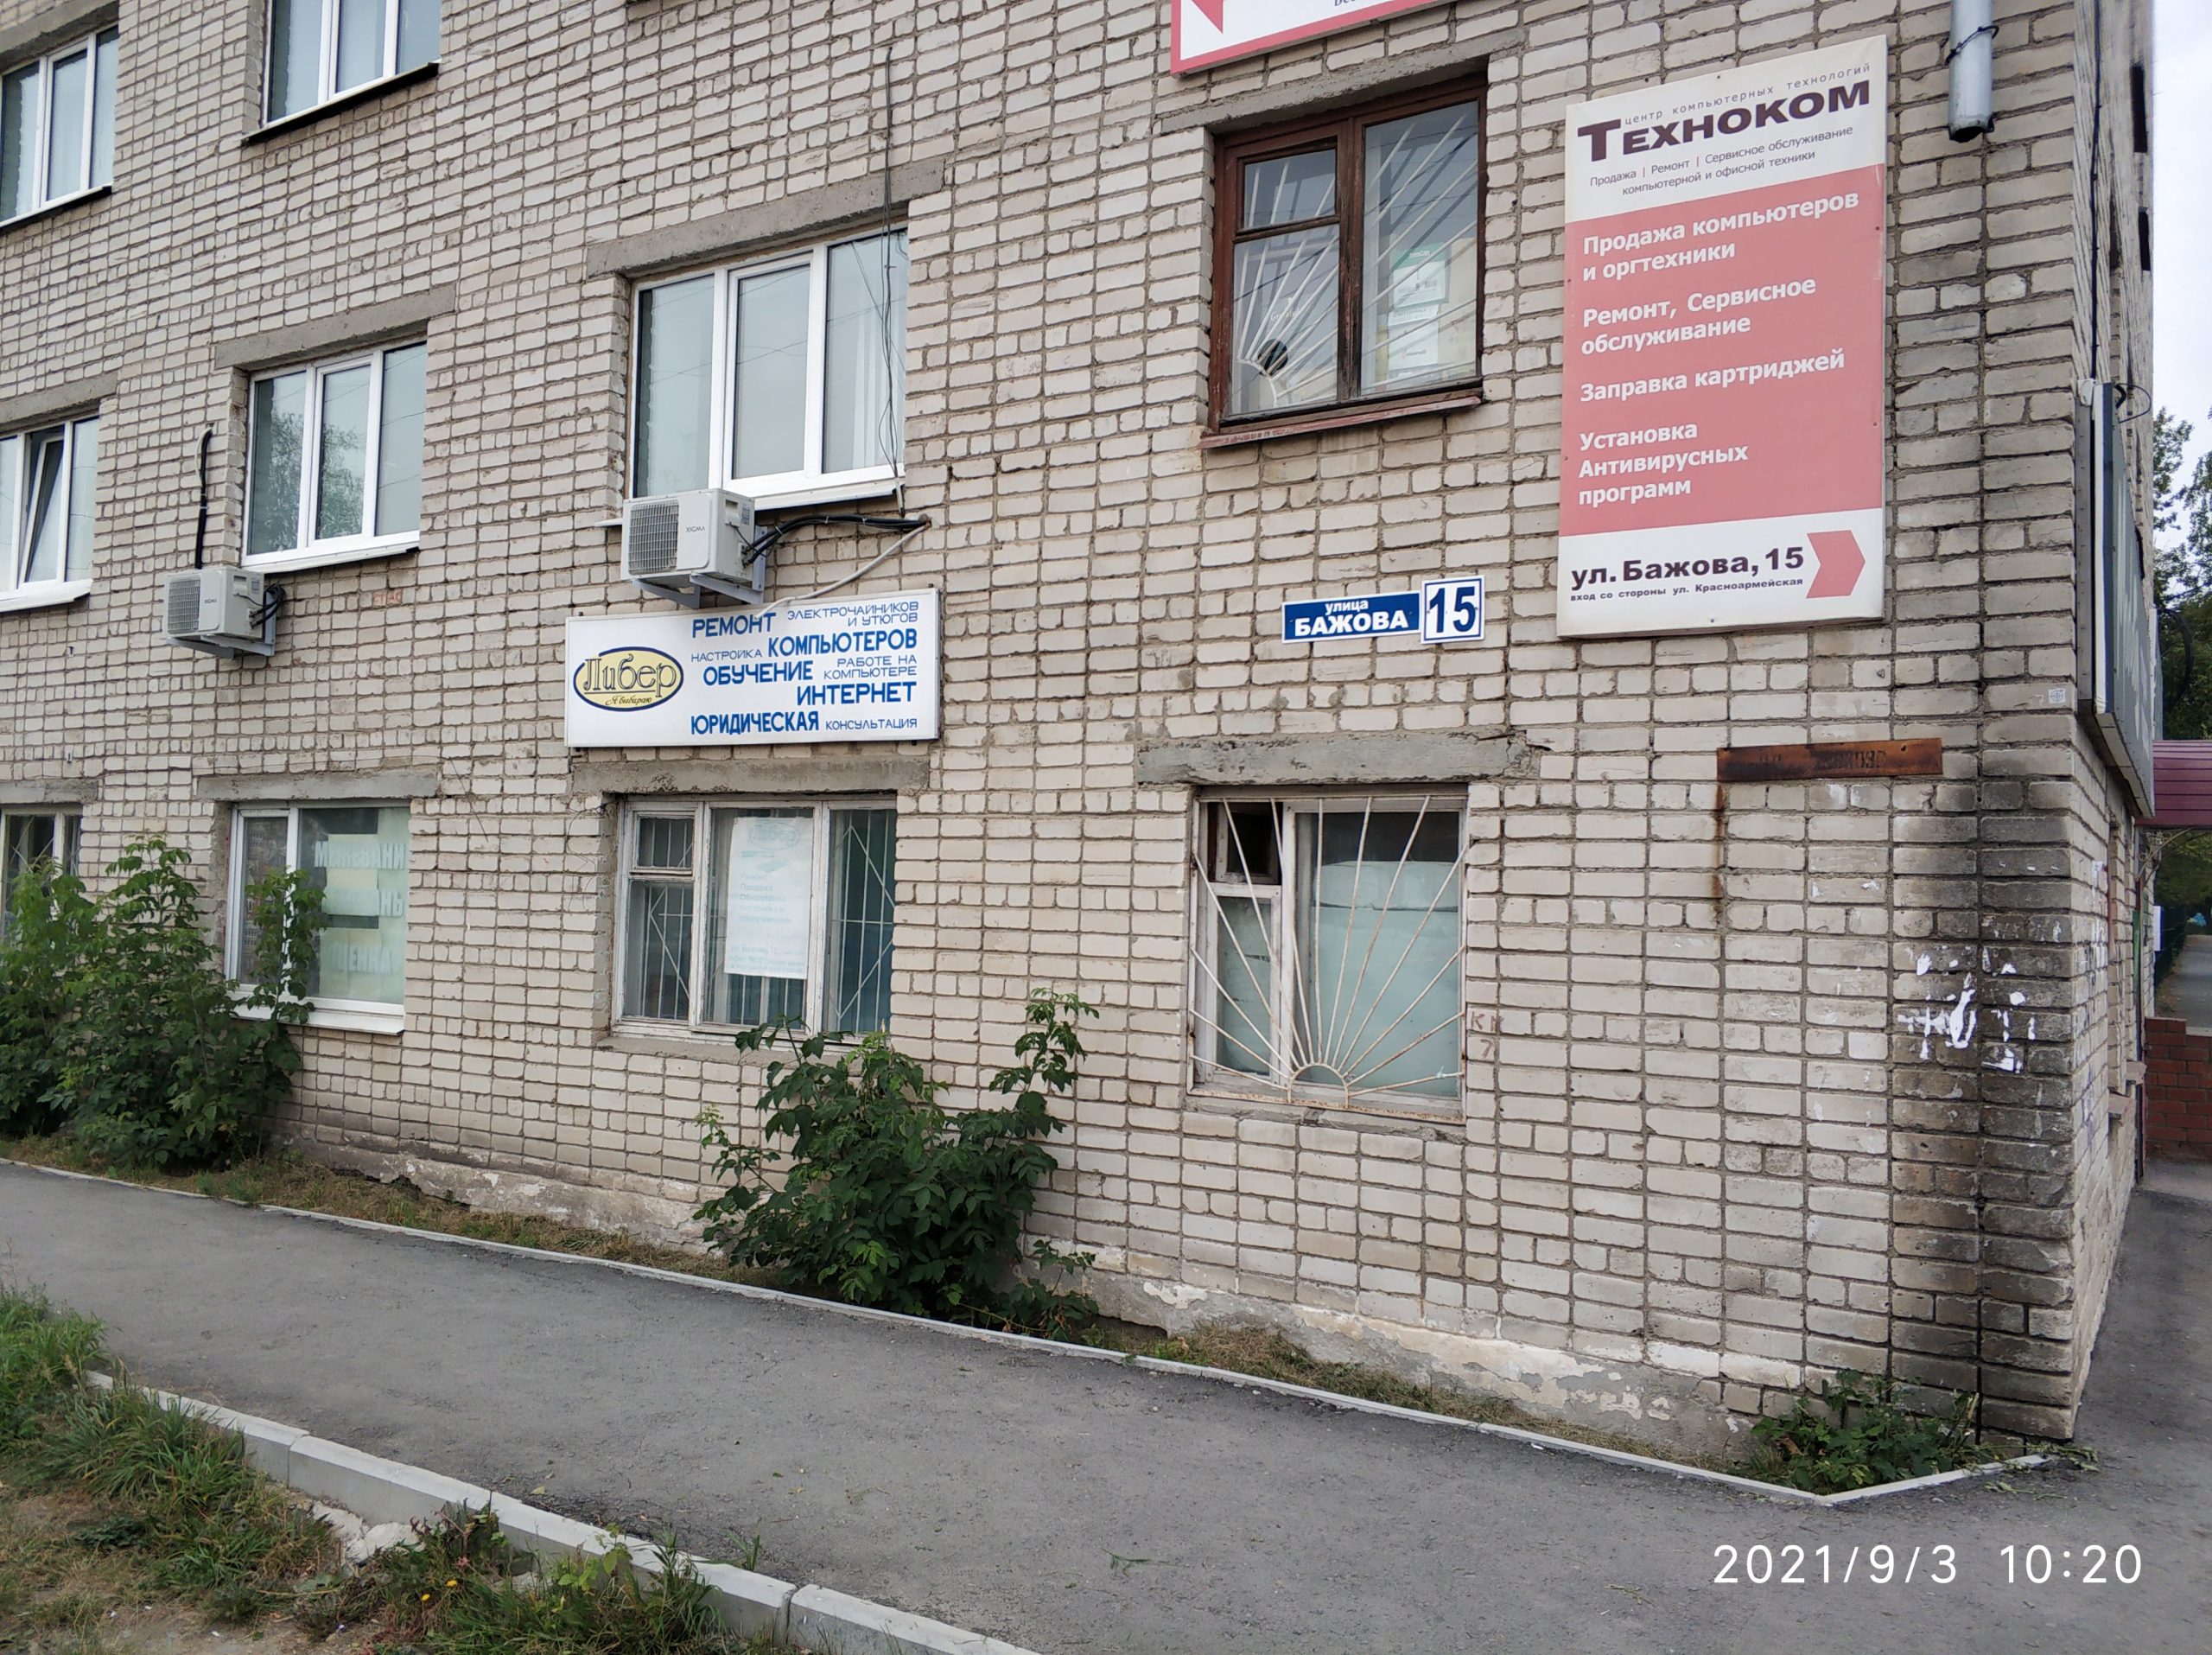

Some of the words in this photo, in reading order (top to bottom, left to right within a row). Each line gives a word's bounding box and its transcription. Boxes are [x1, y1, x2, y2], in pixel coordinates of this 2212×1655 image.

[1624, 109, 1663, 126] центр
[1672, 86, 1774, 116] компьютерных
[1786, 62, 1871, 91] технологий
[1577, 80, 1871, 162] ТЕХНОКОМ
[1590, 169, 1637, 188] Продажа
[1650, 159, 1690, 175] Ремонт
[1704, 143, 1765, 166] Сервисное
[1768, 125, 1853, 153] обслуживание
[1622, 171, 1702, 196] компьютерной
[1705, 171, 1713, 180] и
[1715, 158, 1764, 180] офисной
[1768, 150, 1816, 169] техники
[1583, 223, 1686, 257] Продажа
[1692, 191, 1859, 237] компьютеров
[1582, 265, 1597, 282] и
[1602, 242, 1736, 281] оргтехники
[1582, 301, 1678, 328] Ремонт,
[1687, 277, 1817, 313] Сервисное
[1580, 315, 1751, 356] обслуживание
[1580, 372, 1688, 403] Заправка
[1694, 347, 1846, 388] картриджей
[1579, 422, 1698, 452] Установка
[1578, 445, 1750, 479] Антивирусных
[1578, 480, 1692, 508] программ
[1764, 546, 1804, 570] 15
[1570, 592, 1597, 602] вход
[1599, 591, 1614, 600] со
[1618, 587, 1667, 599] стороны
[1672, 586, 1690, 596] ул.
[1694, 577, 1804, 595] Красноармейская
[692, 612, 777, 639] РЕМОНТ
[787, 602, 919, 621] ЭЛЕКТРОЧАЙНИКОВ
[848, 617, 857, 627] И
[862, 612, 918, 626] УТЮГОВ
[1294, 609, 1409, 637] БАЖОВА
[1428, 586, 1477, 633] 15
[1325, 600, 1369, 616] улица
[768, 628, 918, 658] КОМПЬЮТЕРОВ
[582, 653, 677, 698] Либер
[703, 660, 814, 686] ОБУЧЕНИЕ
[837, 655, 893, 668] РАБОТЕ
[899, 654, 918, 665] НА
[823, 665, 918, 680] КОМПЬЮТЕРЕ
[605, 696, 619, 706] Я
[619, 695, 652, 706] выбираю
[797, 681, 917, 706] ИНТЕРНЕТ
[690, 710, 820, 735] ЮРИДИЧЕСКАЯ
[825, 718, 918, 730] КОНСУЛЬТАЦИЯ
